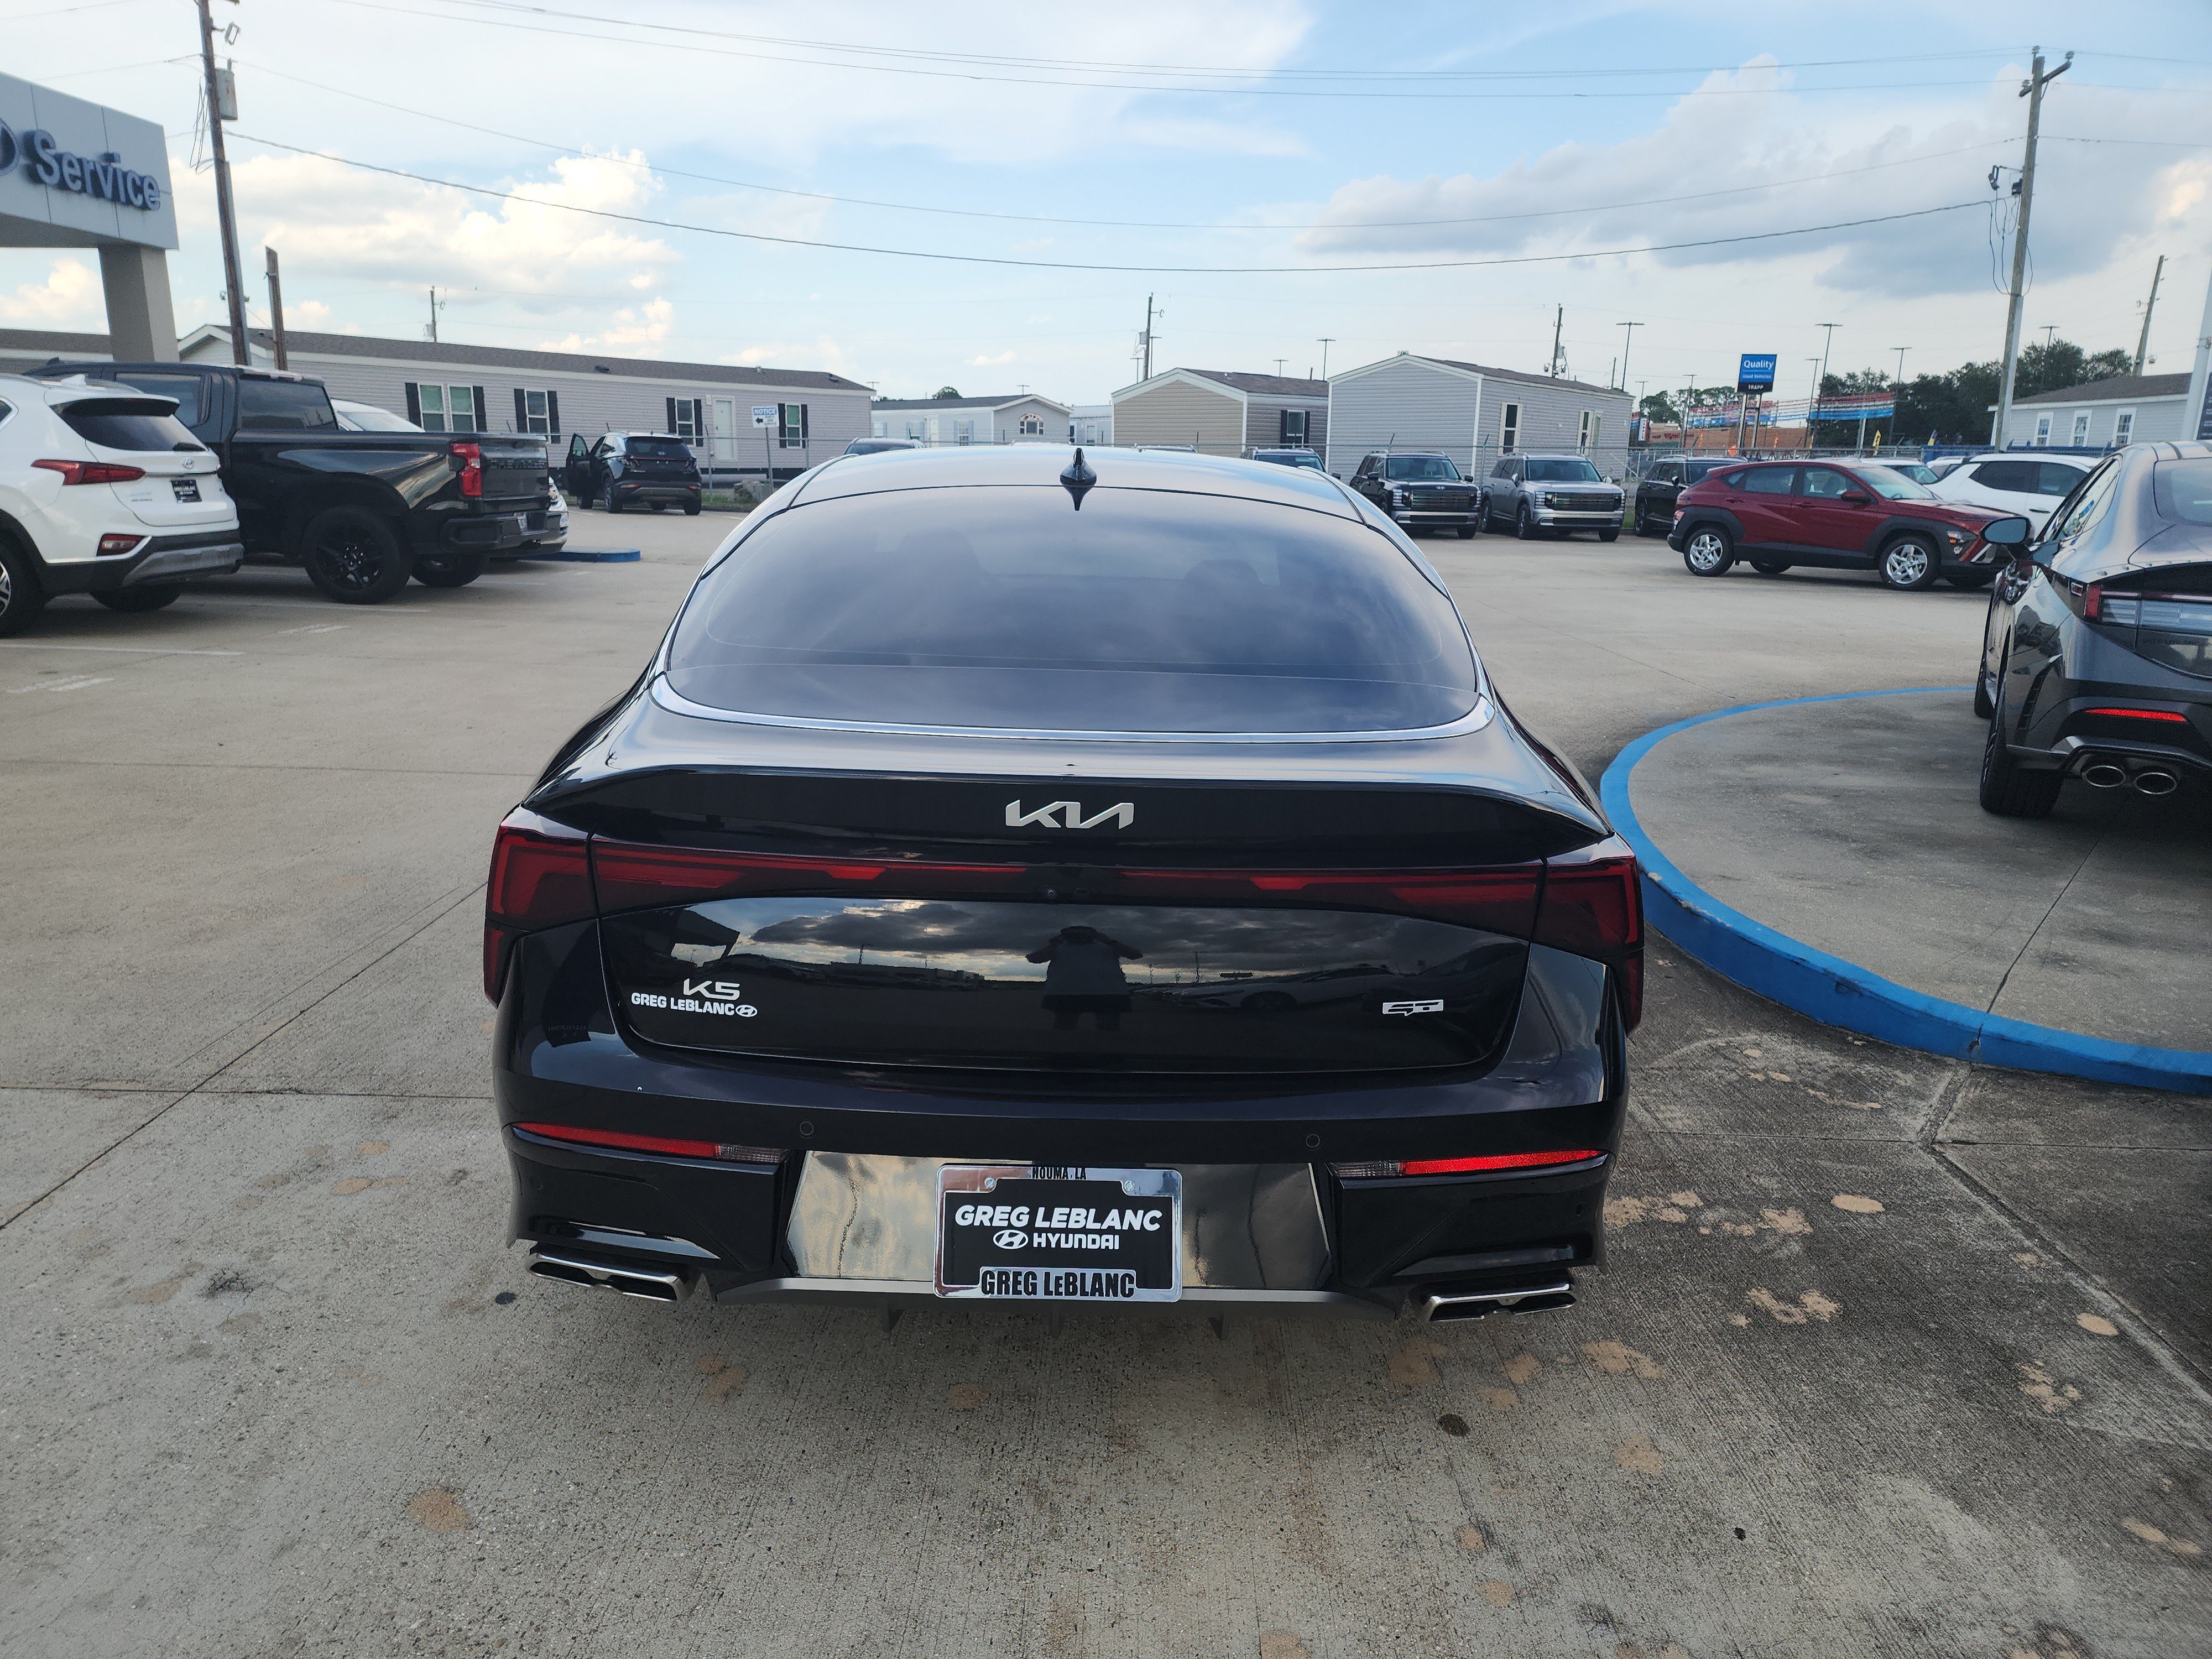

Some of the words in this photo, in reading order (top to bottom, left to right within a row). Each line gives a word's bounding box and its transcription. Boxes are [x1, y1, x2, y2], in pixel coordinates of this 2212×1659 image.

[32, 129, 160, 211] Service
[1744, 359, 1774, 370] Quality
[1005, 799, 1135, 830] KIA
[684, 978, 740, 1000] K5
[631, 992, 667, 1009] GREG
[1075, 1167, 1087, 1180] LA
[954, 1204, 1030, 1228] GREG
[1034, 1206, 1163, 1232] LEBLANC
[1032, 1232, 1120, 1250] HYUNDAI
[980, 1270, 1038, 1296] GREG
